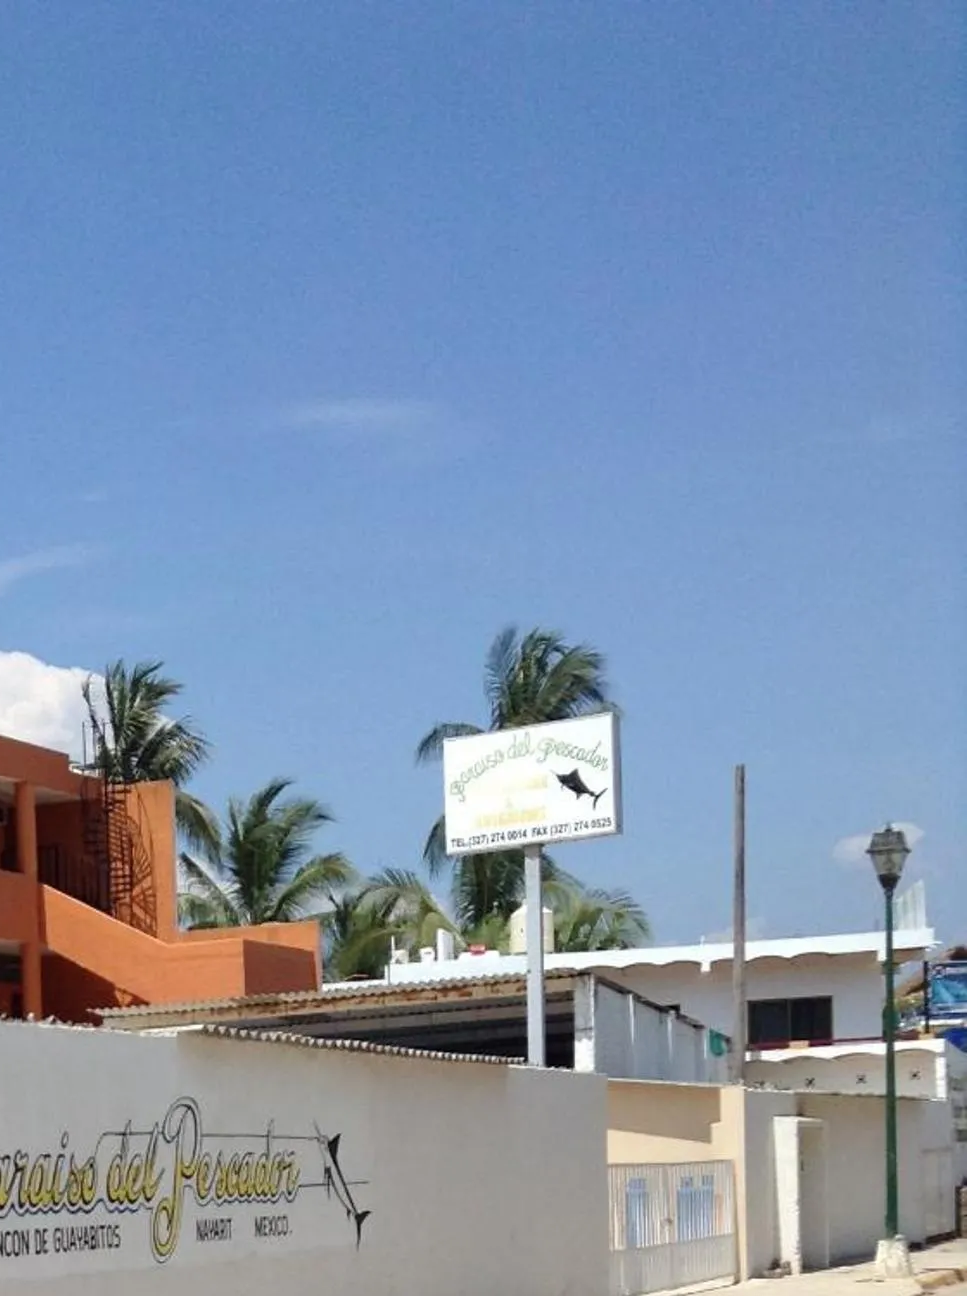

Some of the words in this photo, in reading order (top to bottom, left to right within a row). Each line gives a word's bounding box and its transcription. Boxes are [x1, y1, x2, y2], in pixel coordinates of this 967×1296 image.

[506, 732, 535, 760] del
[531, 824, 548, 837] FAX
[106, 1119, 165, 1206] del
[153, 1096, 301, 1264] Pescador
[33, 1227, 49, 1254] DE
[52, 1224, 122, 1253] GUAYABITOS
